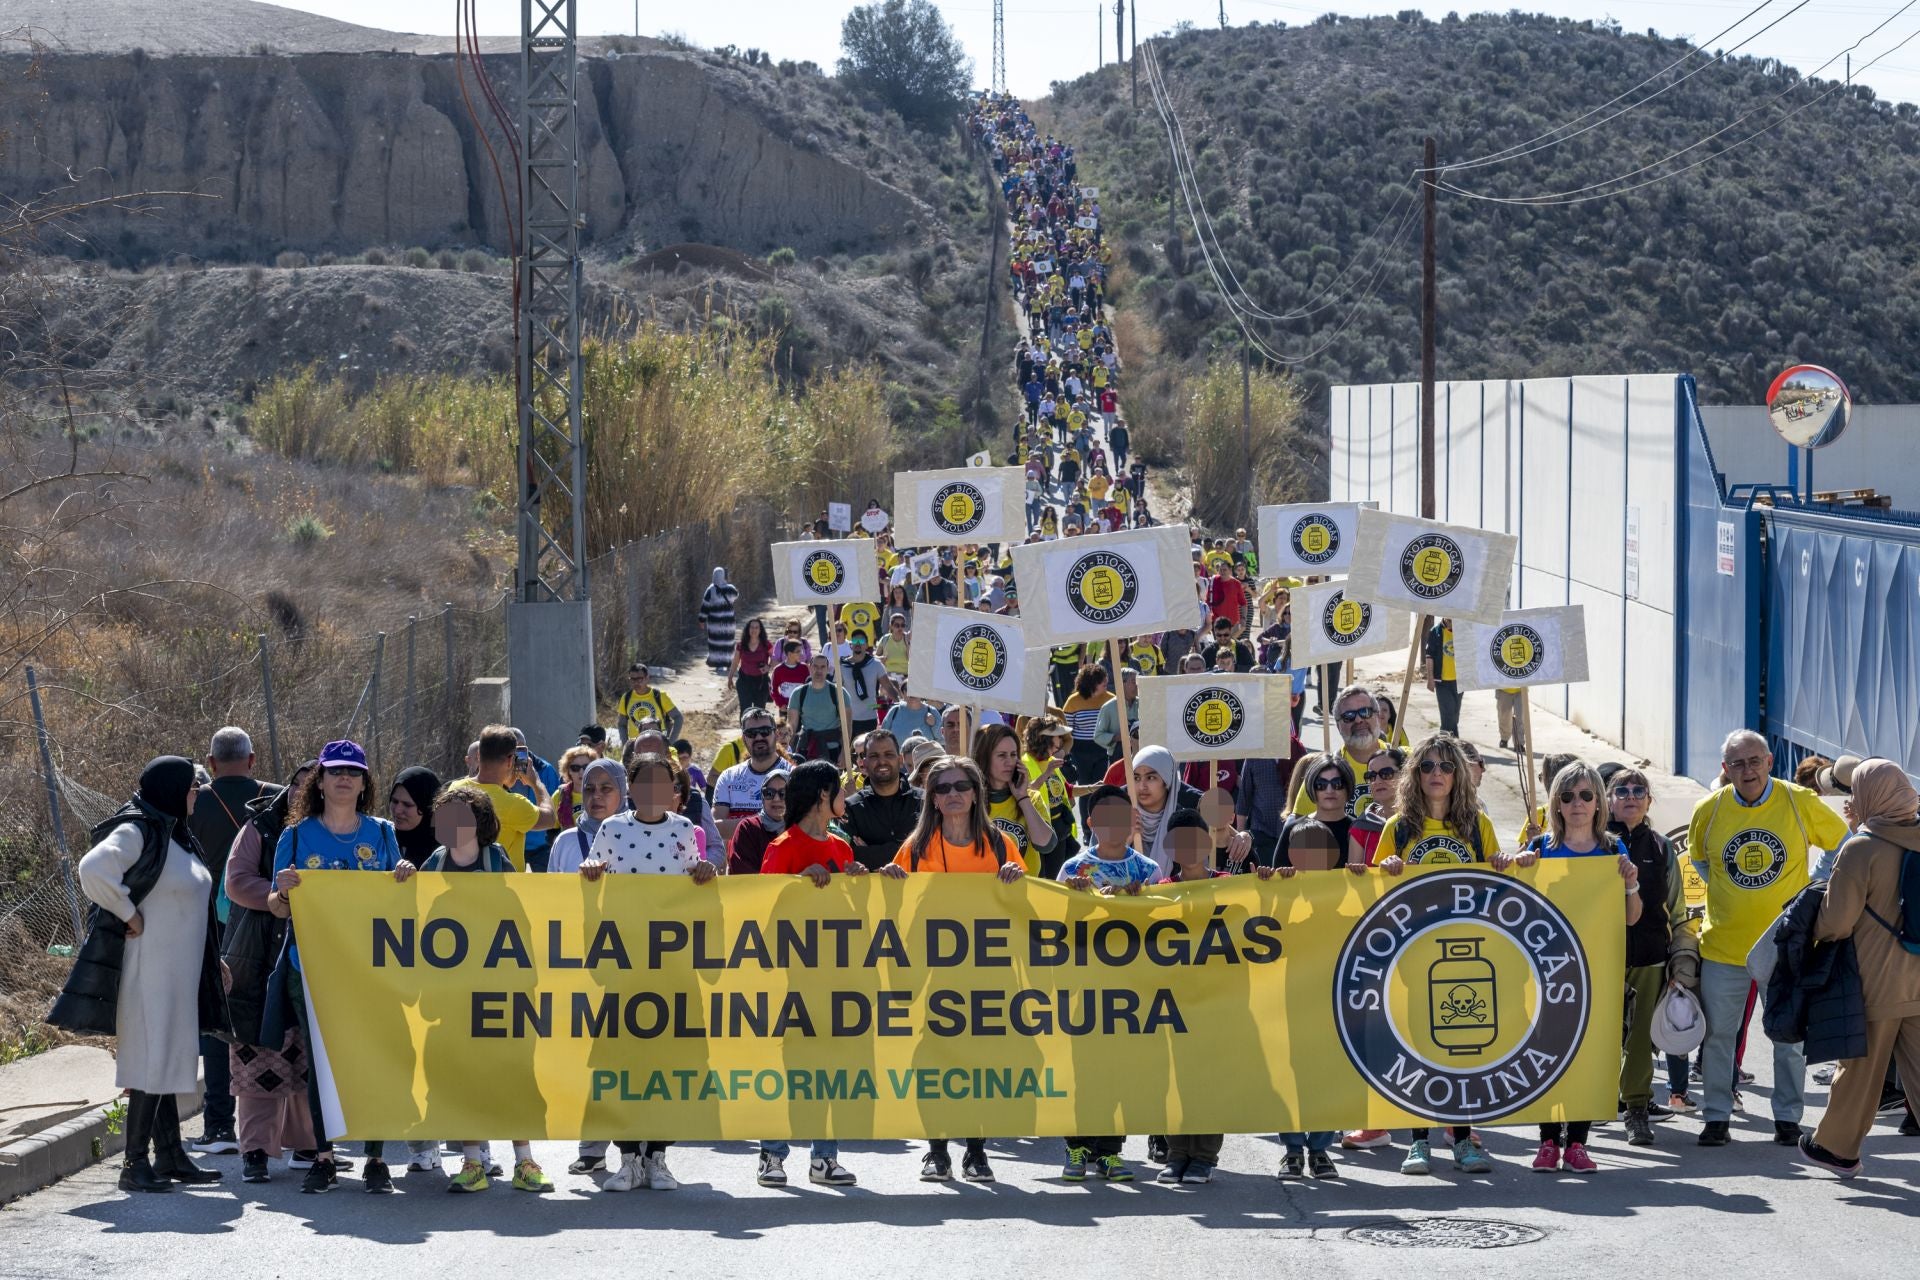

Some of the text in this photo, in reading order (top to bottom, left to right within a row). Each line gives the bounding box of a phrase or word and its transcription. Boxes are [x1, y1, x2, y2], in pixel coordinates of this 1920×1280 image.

[935, 489, 949, 512] STOP
[941, 519, 978, 532] MOLINA
[1294, 520, 1307, 542] STOP
[1300, 549, 1334, 562] MOLINA
[1404, 539, 1425, 566] STOP
[1070, 562, 1087, 595] STOP
[1408, 577, 1451, 596] MOLINA
[1082, 600, 1131, 620] MOLINA
[1326, 597, 1338, 623] STOP
[953, 630, 971, 657] STOP
[1331, 626, 1365, 642] MOLINA
[1493, 631, 1506, 655] STOP
[959, 669, 998, 687] MOLINA
[1501, 661, 1538, 676] MOLINA
[1186, 696, 1203, 721] STOP
[1194, 728, 1237, 744] MOLINA
[1411, 843, 1429, 861] TOP
[1734, 869, 1777, 886] MOLINA
[372, 905, 1283, 970] NO A LA PLANTA DE BIOGÁS
[1349, 903, 1412, 1010] STOP
[1451, 884, 1576, 1004] BIOGÁS
[471, 988, 1189, 1040] EN MOLINA DE SEGURA
[592, 1067, 1068, 1101] PLATAFORMA VECINAL
[1382, 1047, 1558, 1109] MOLINA
